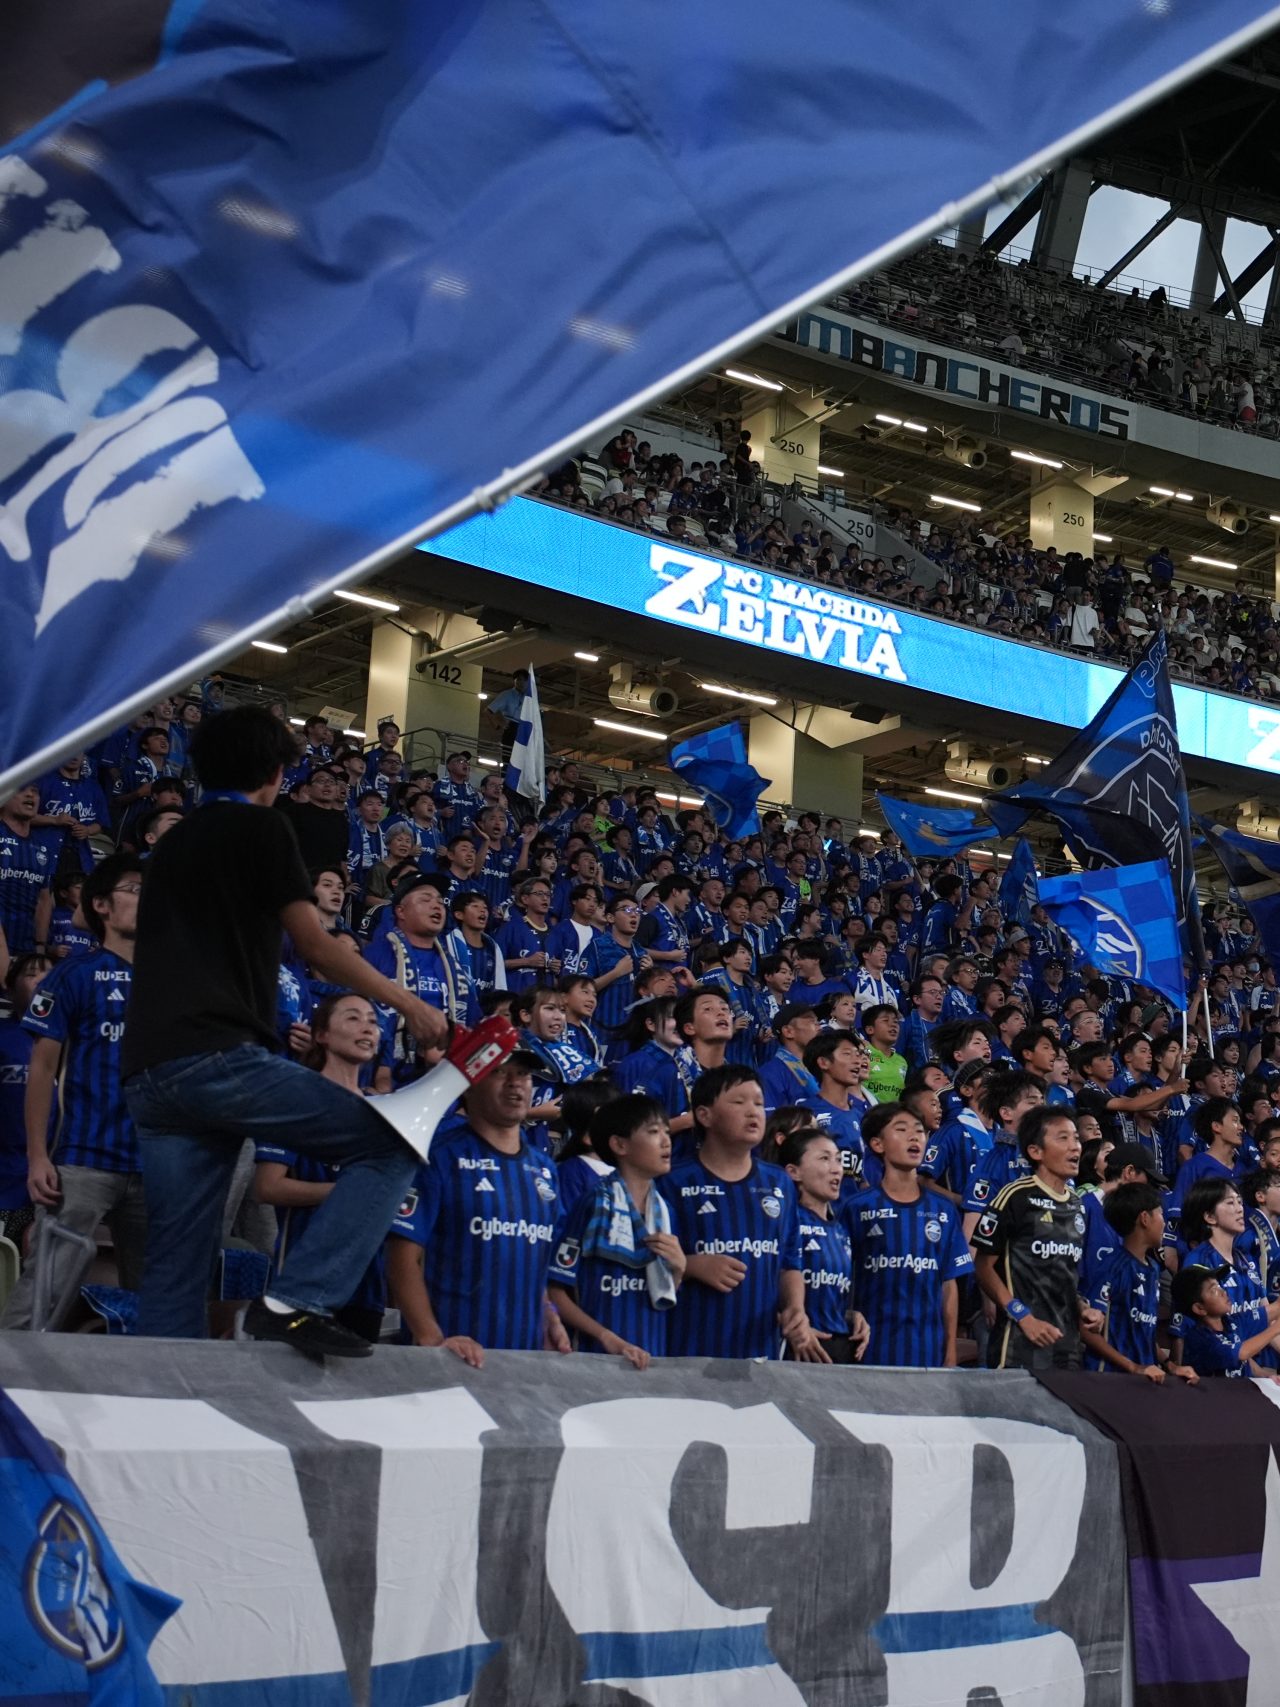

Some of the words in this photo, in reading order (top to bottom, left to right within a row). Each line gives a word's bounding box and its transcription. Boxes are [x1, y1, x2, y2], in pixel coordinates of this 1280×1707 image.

[779, 439, 805, 456] 250
[847, 519, 874, 538] 250
[1062, 512, 1085, 527] 250
[723, 565, 763, 595] FC
[770, 578, 902, 634] MACHIDA
[645, 543, 907, 681] ZELVIA
[429, 662, 462, 685] 142
[469, 1216, 554, 1245] CyberAgent
[695, 1237, 780, 1259] CyberAgent
